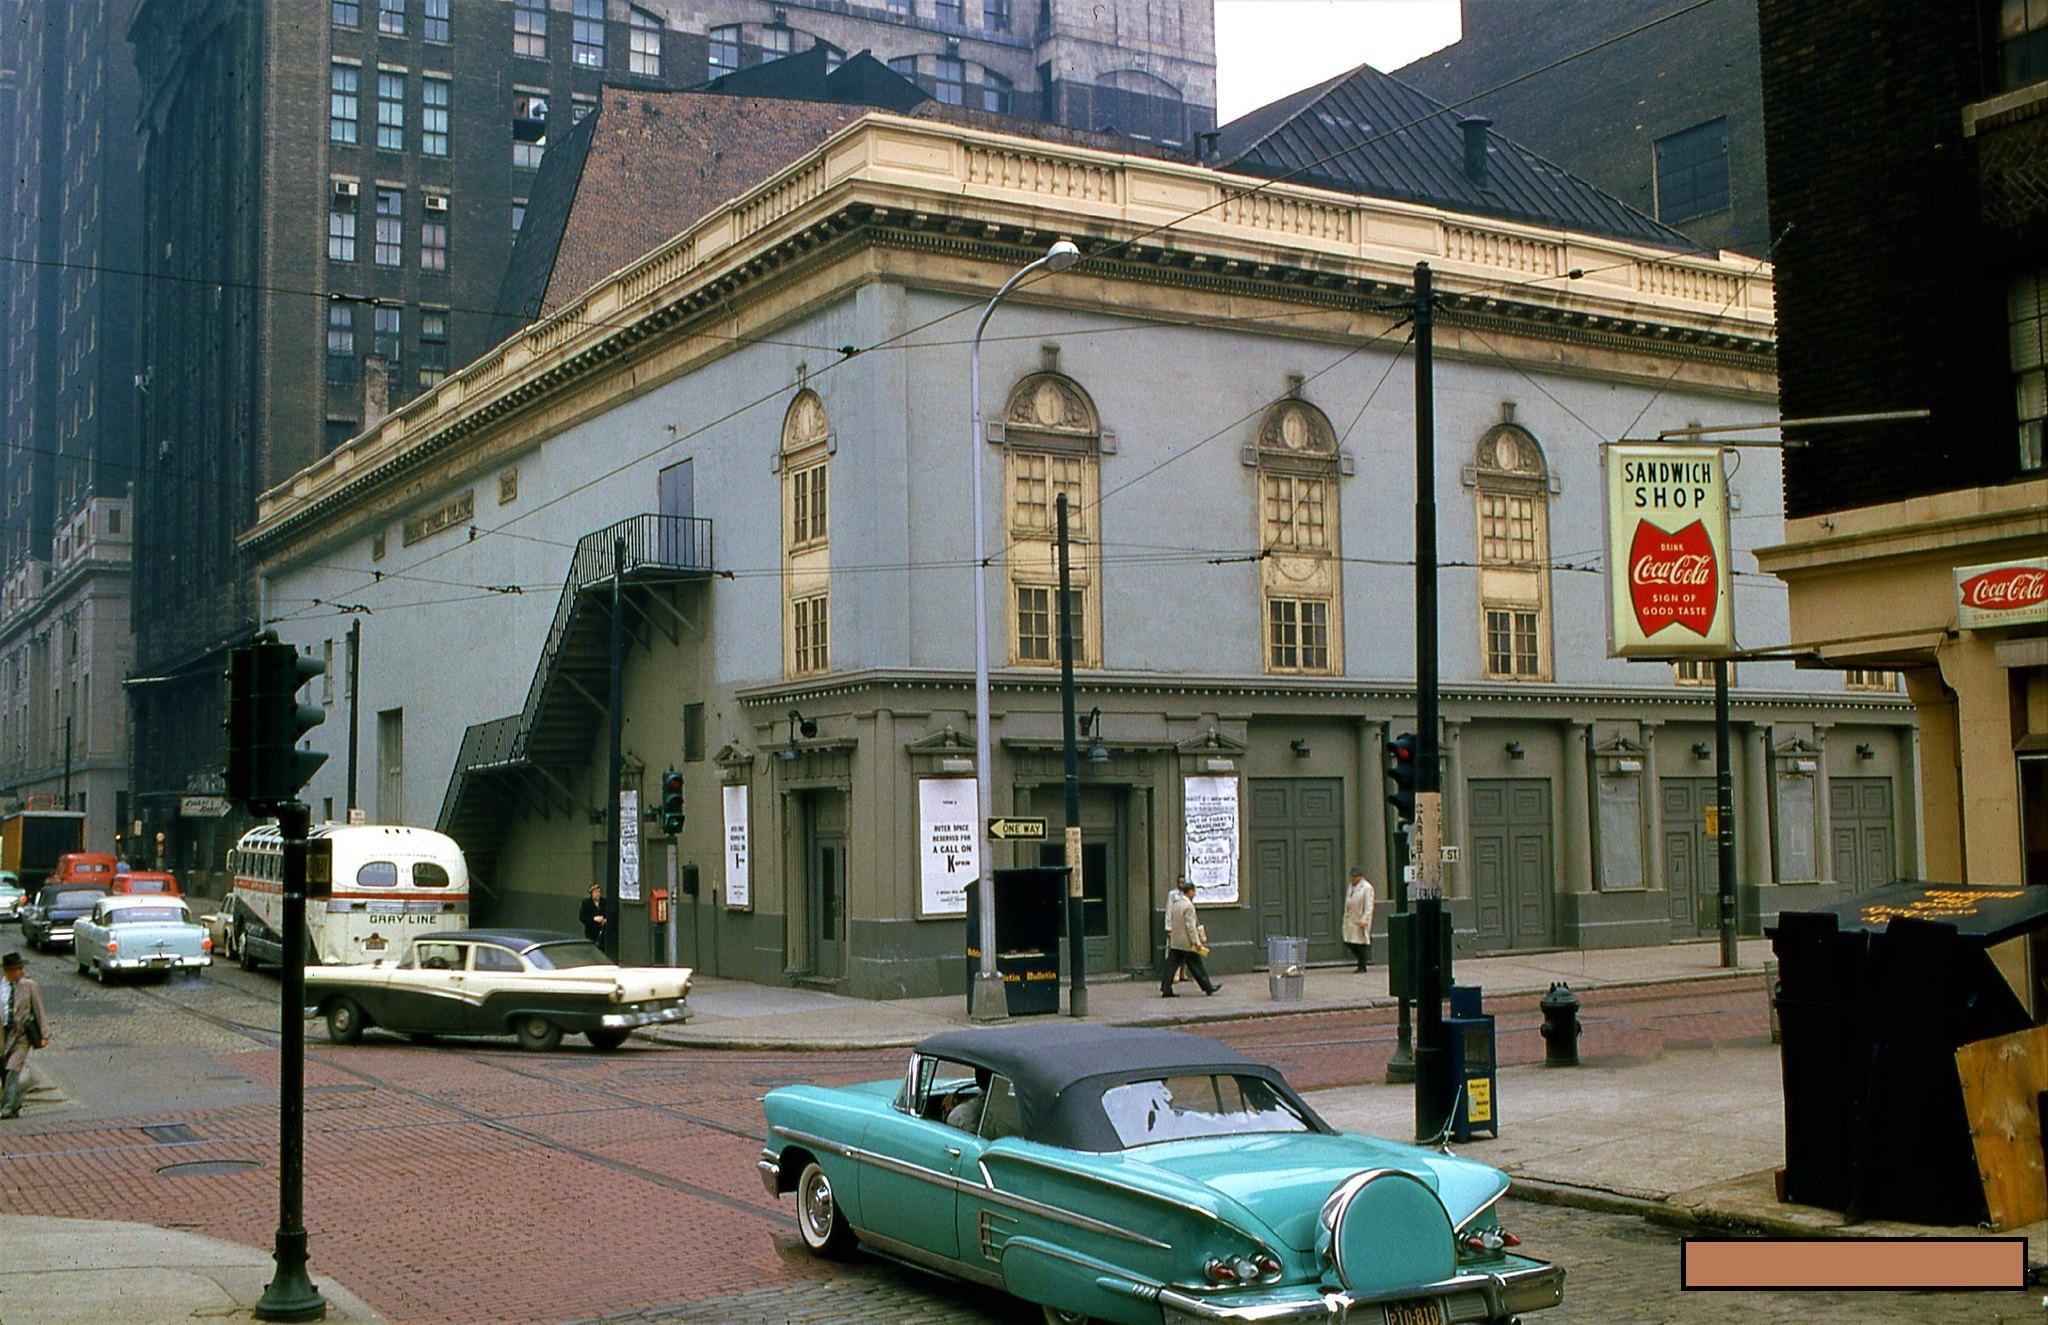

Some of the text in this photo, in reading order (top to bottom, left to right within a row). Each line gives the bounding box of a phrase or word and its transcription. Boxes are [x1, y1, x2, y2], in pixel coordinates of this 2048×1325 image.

[1625, 462, 1711, 484] SANDWICH
[1635, 487, 1705, 508] SHOP
[1661, 543, 1684, 551] DRINK
[1633, 554, 1712, 585] Coca-Cola
[1973, 571, 2046, 605] Coca-Cola
[1652, 594, 1697, 603] SIGN OF
[1642, 607, 1707, 616] GOOD TASTE
[1002, 823, 1041, 833] ONE WAY
[933, 845, 972, 854] A CALL ON
[369, 915, 437, 924] GRAY LINE
[1026, 971, 1057, 981] Bulletin
